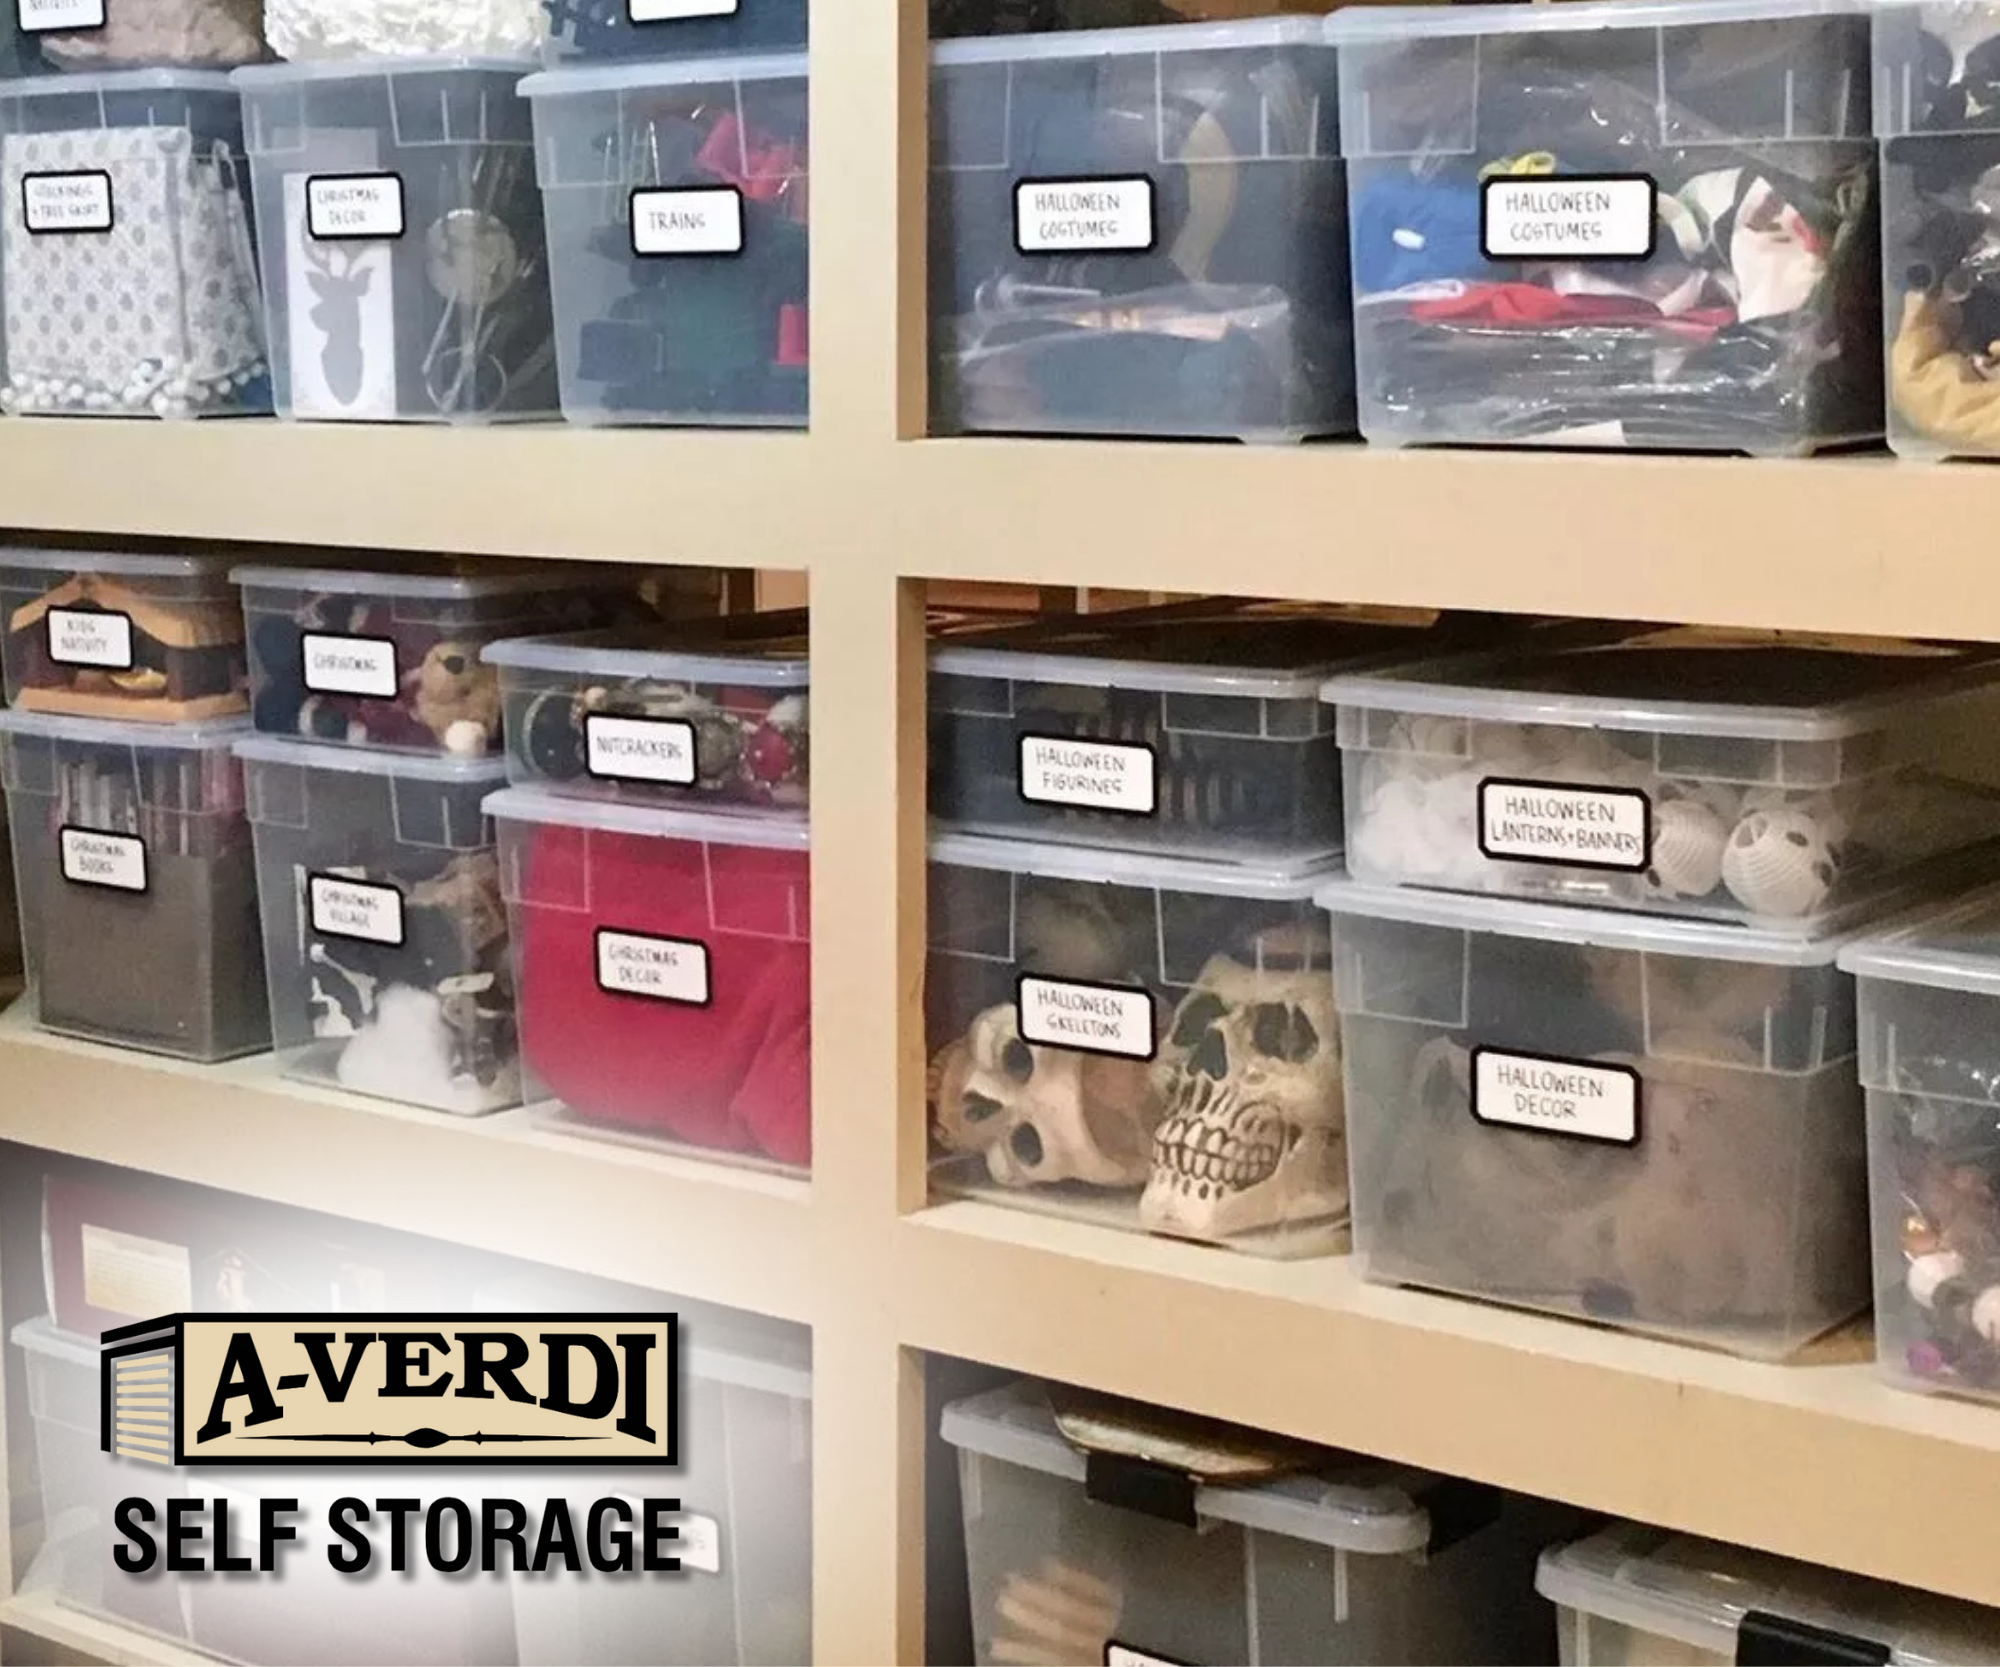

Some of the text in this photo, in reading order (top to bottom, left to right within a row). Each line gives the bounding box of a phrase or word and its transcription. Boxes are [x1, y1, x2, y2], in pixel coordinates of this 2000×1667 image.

[317, 188, 379, 203] CHRISTMAS
[1035, 192, 1120, 212] HALLOWEEN
[1506, 191, 1610, 213] HALLOWEEN
[648, 211, 706, 231] TRAINS
[1039, 220, 1118, 240] COSTUMES
[1510, 221, 1602, 241] COSTUMES
[597, 735, 683, 758] NUTCRACKERS
[1035, 746, 1125, 772] HALLOWEEN
[1042, 771, 1122, 795] FIGURINES
[1505, 795, 1615, 823] HALLOWEEN
[608, 943, 678, 967] CHRISTMAS
[618, 965, 663, 985] DECOR
[1037, 988, 1123, 1017] HALLOWEEN
[1046, 1013, 1121, 1039] SKELETONS
[1497, 1064, 1605, 1098] HALLOWEEN
[1513, 1092, 1577, 1118] DECOR
